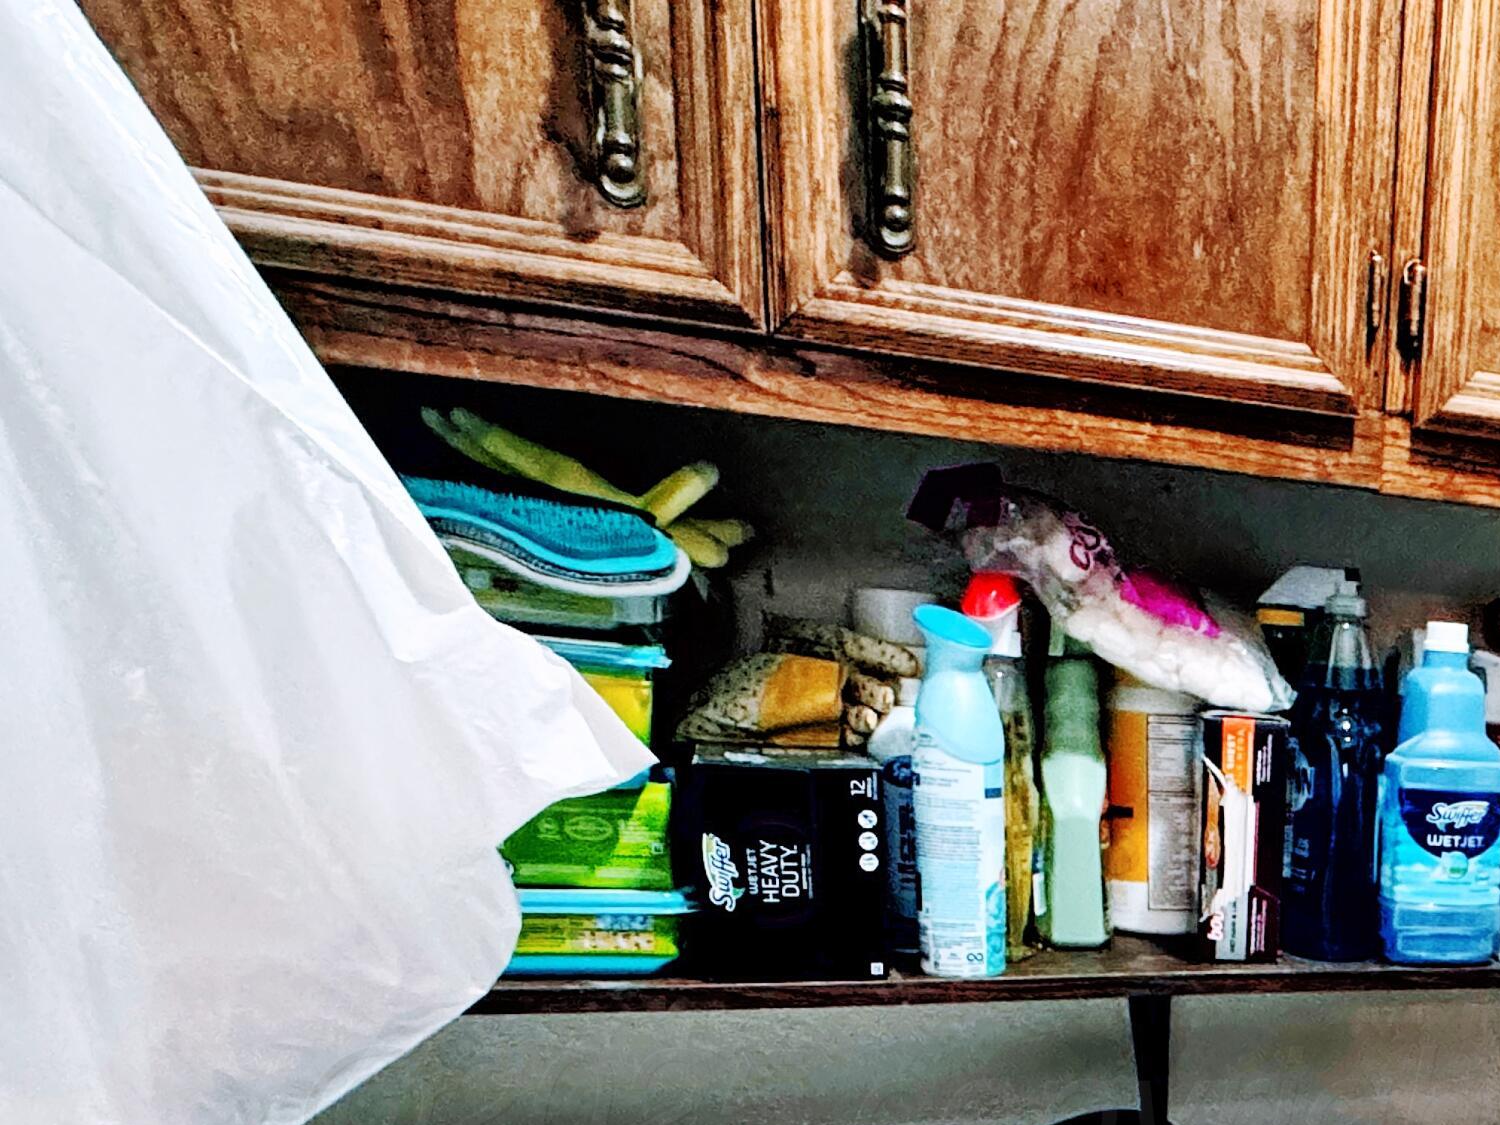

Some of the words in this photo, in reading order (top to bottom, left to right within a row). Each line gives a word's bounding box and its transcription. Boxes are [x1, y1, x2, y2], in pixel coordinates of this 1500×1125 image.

[1426, 801, 1491, 829] Swiffer
[1426, 833, 1485, 848] WETJET
[702, 832, 739, 911] Swiffer
[746, 847, 759, 895] WETJET
[759, 839, 780, 904] HEAVY
[780, 845, 801, 898] DUTY
